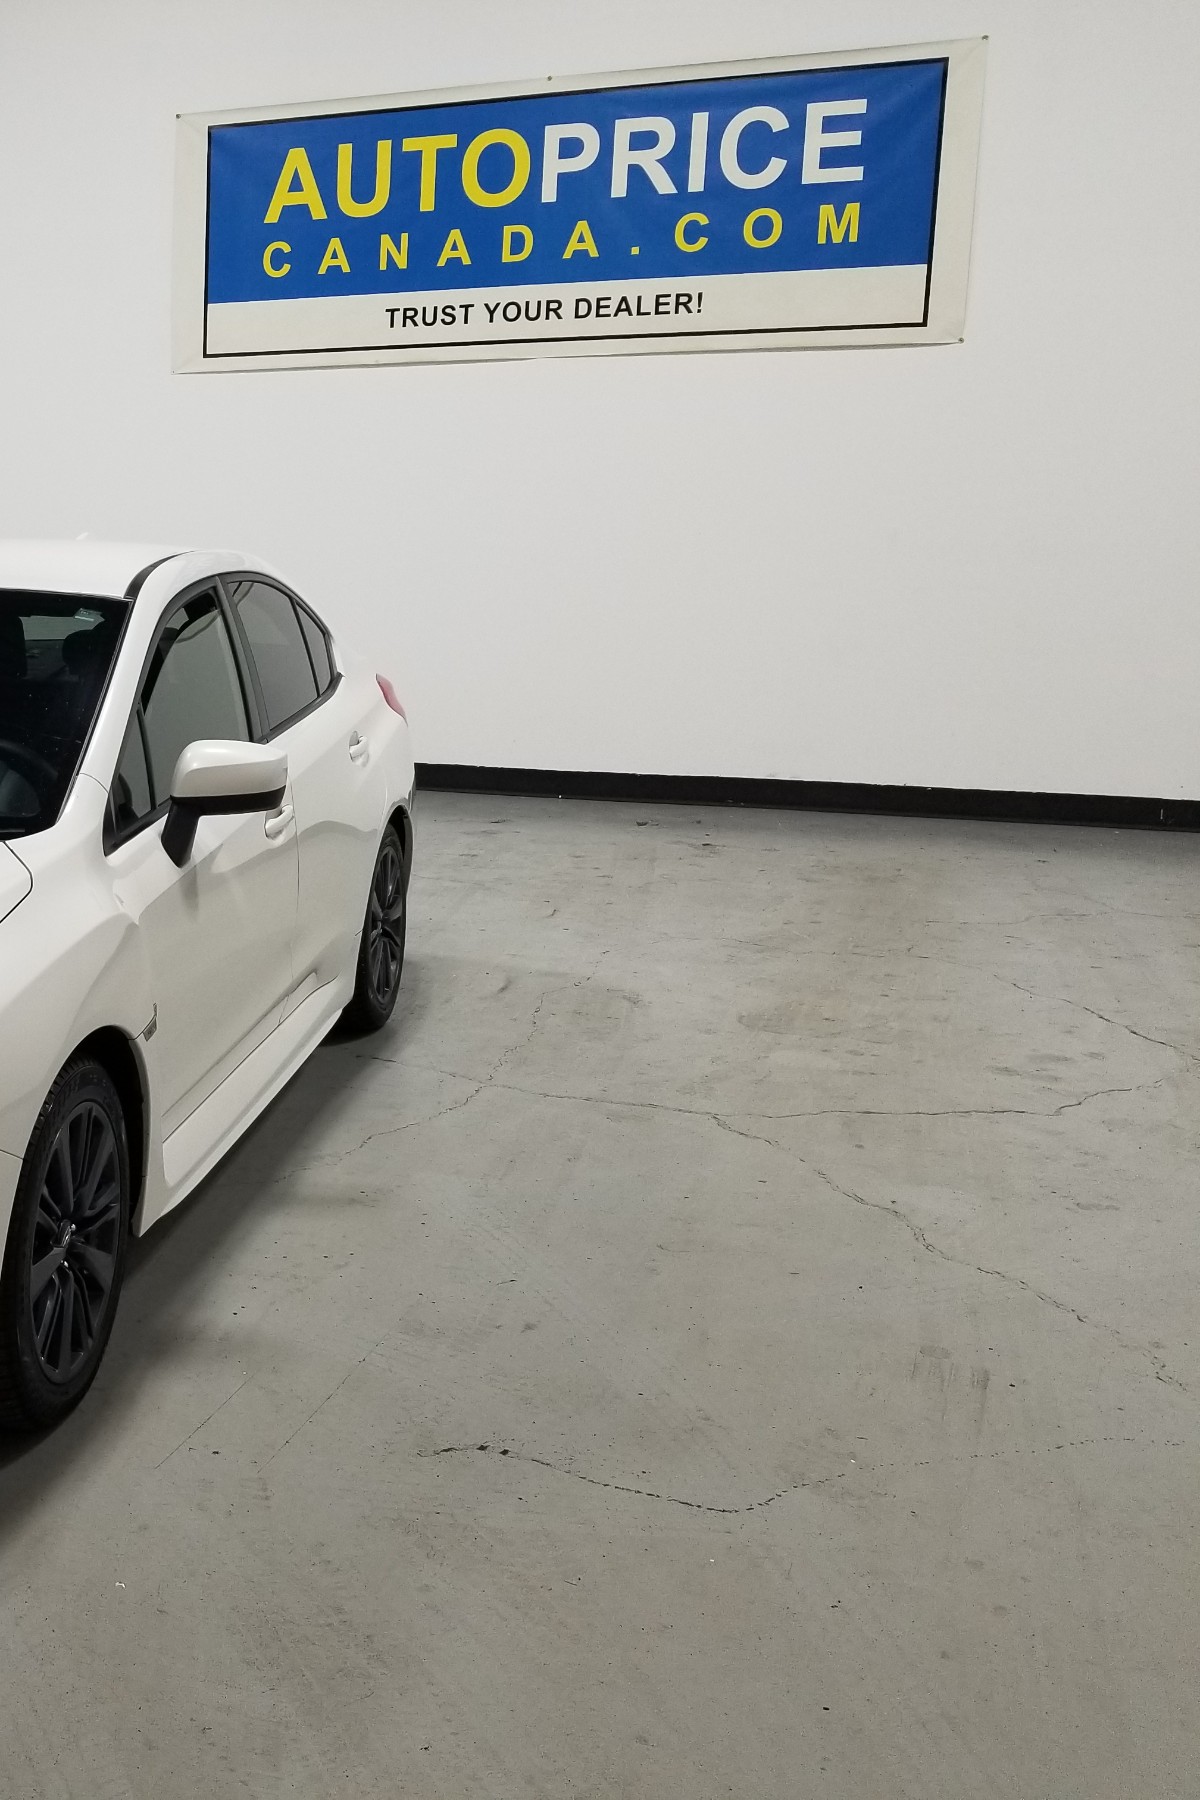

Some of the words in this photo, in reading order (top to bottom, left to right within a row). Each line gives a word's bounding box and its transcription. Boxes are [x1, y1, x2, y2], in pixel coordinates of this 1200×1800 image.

[263, 98, 868, 224] AUTOPRICE
[262, 202, 861, 278] CANADA.COM
[384, 303, 475, 329] TRUST
[482, 299, 564, 324] YOUR
[573, 291, 704, 320] DEALER!
